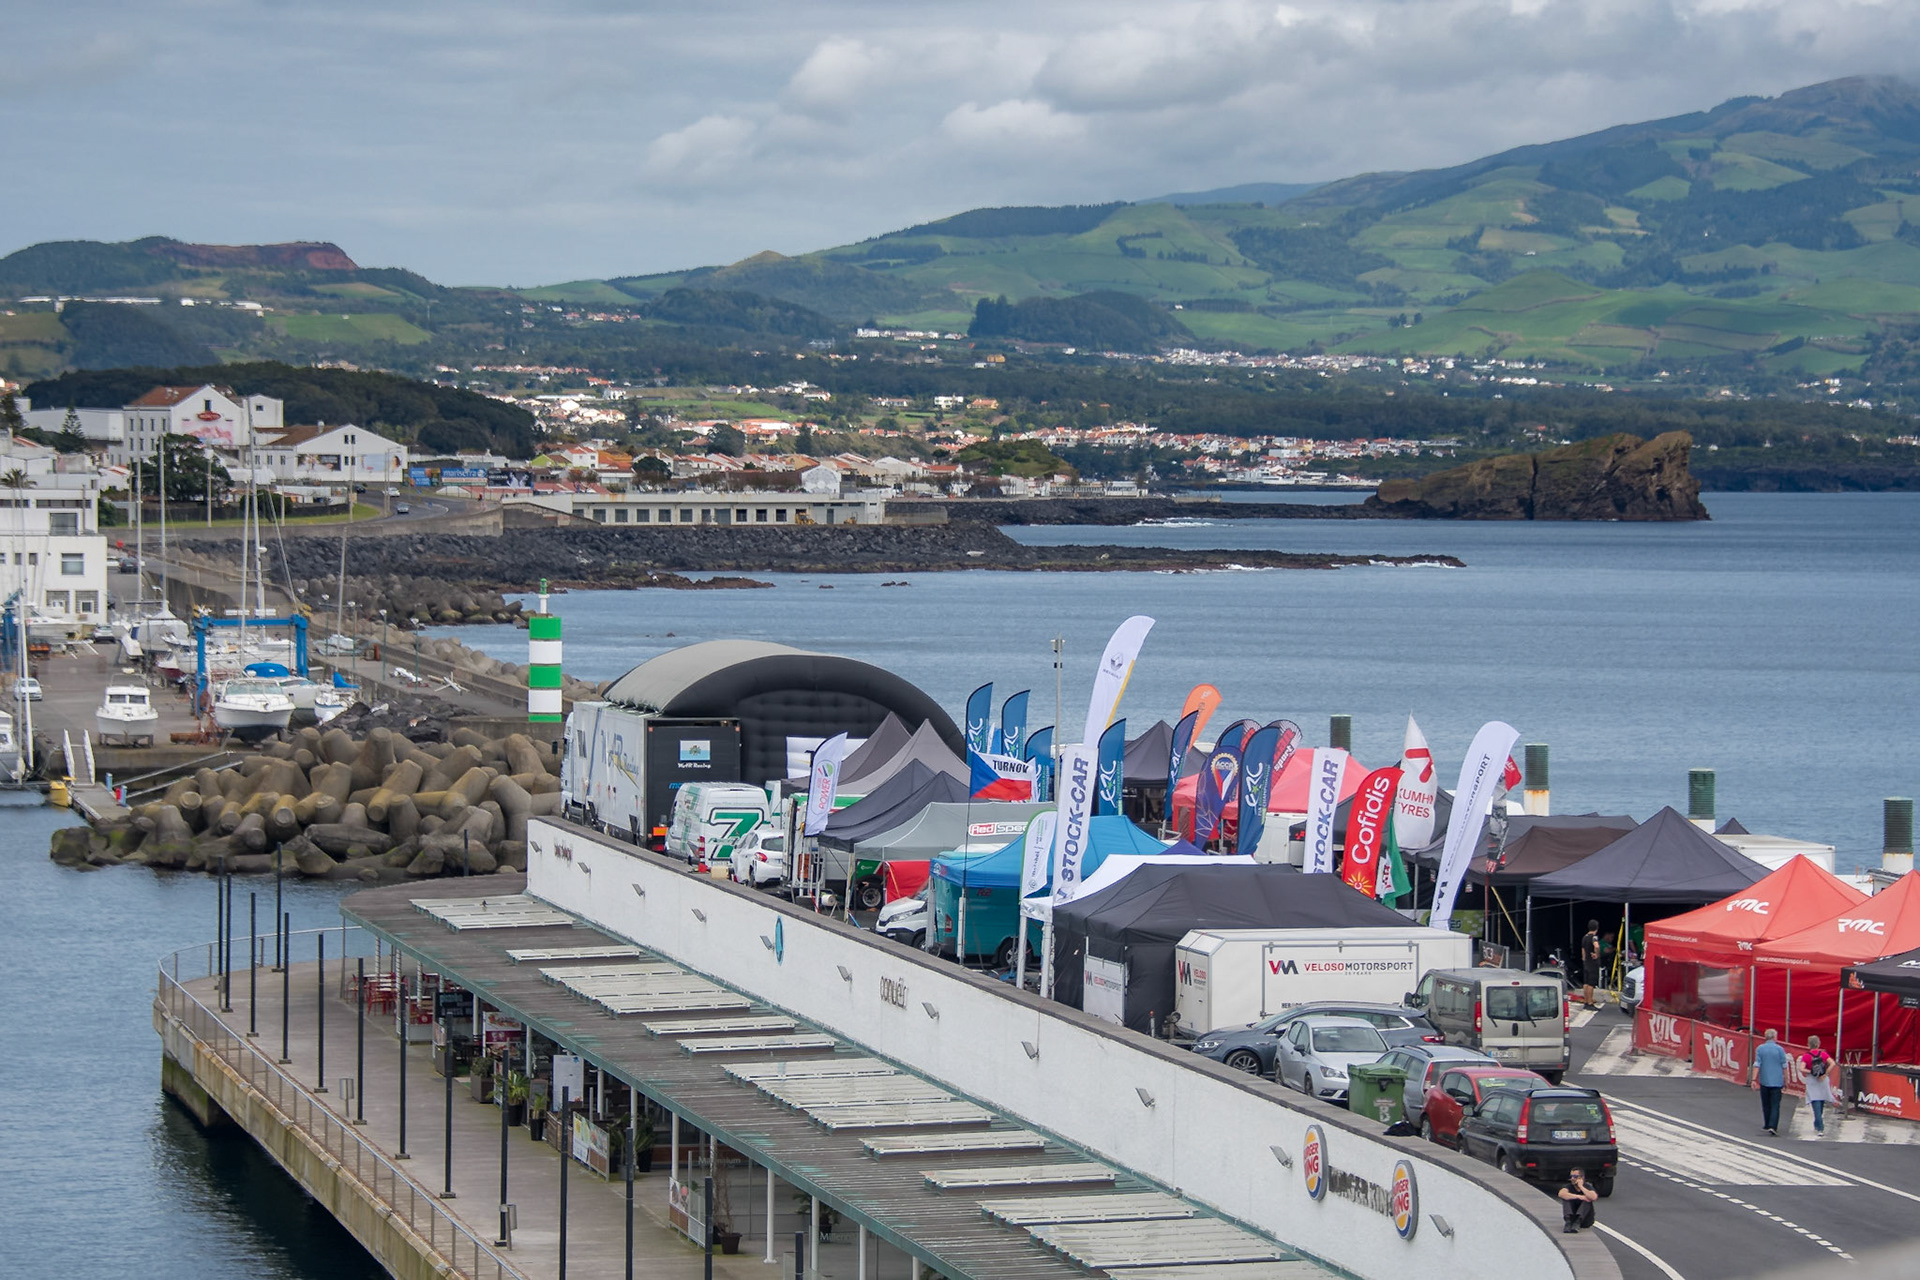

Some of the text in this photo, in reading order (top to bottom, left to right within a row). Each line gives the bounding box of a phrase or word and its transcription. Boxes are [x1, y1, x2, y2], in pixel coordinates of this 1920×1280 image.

[993, 760, 1029, 774] TURNOV
[1274, 744, 1294, 771] sport
[819, 779, 832, 811] POWER
[971, 826, 994, 834] Red
[1061, 757, 1089, 882] STOCK-CAR
[1352, 776, 1390, 865] Cofidis
[1726, 898, 1769, 915] RMC
[1838, 918, 1885, 935] RMC
[1304, 962, 1413, 972] VELOSOMOTORSPORT
[1648, 1012, 1682, 1044] RMC
[1703, 1032, 1740, 1070] RMC
[1858, 1091, 1902, 1108] MMR
